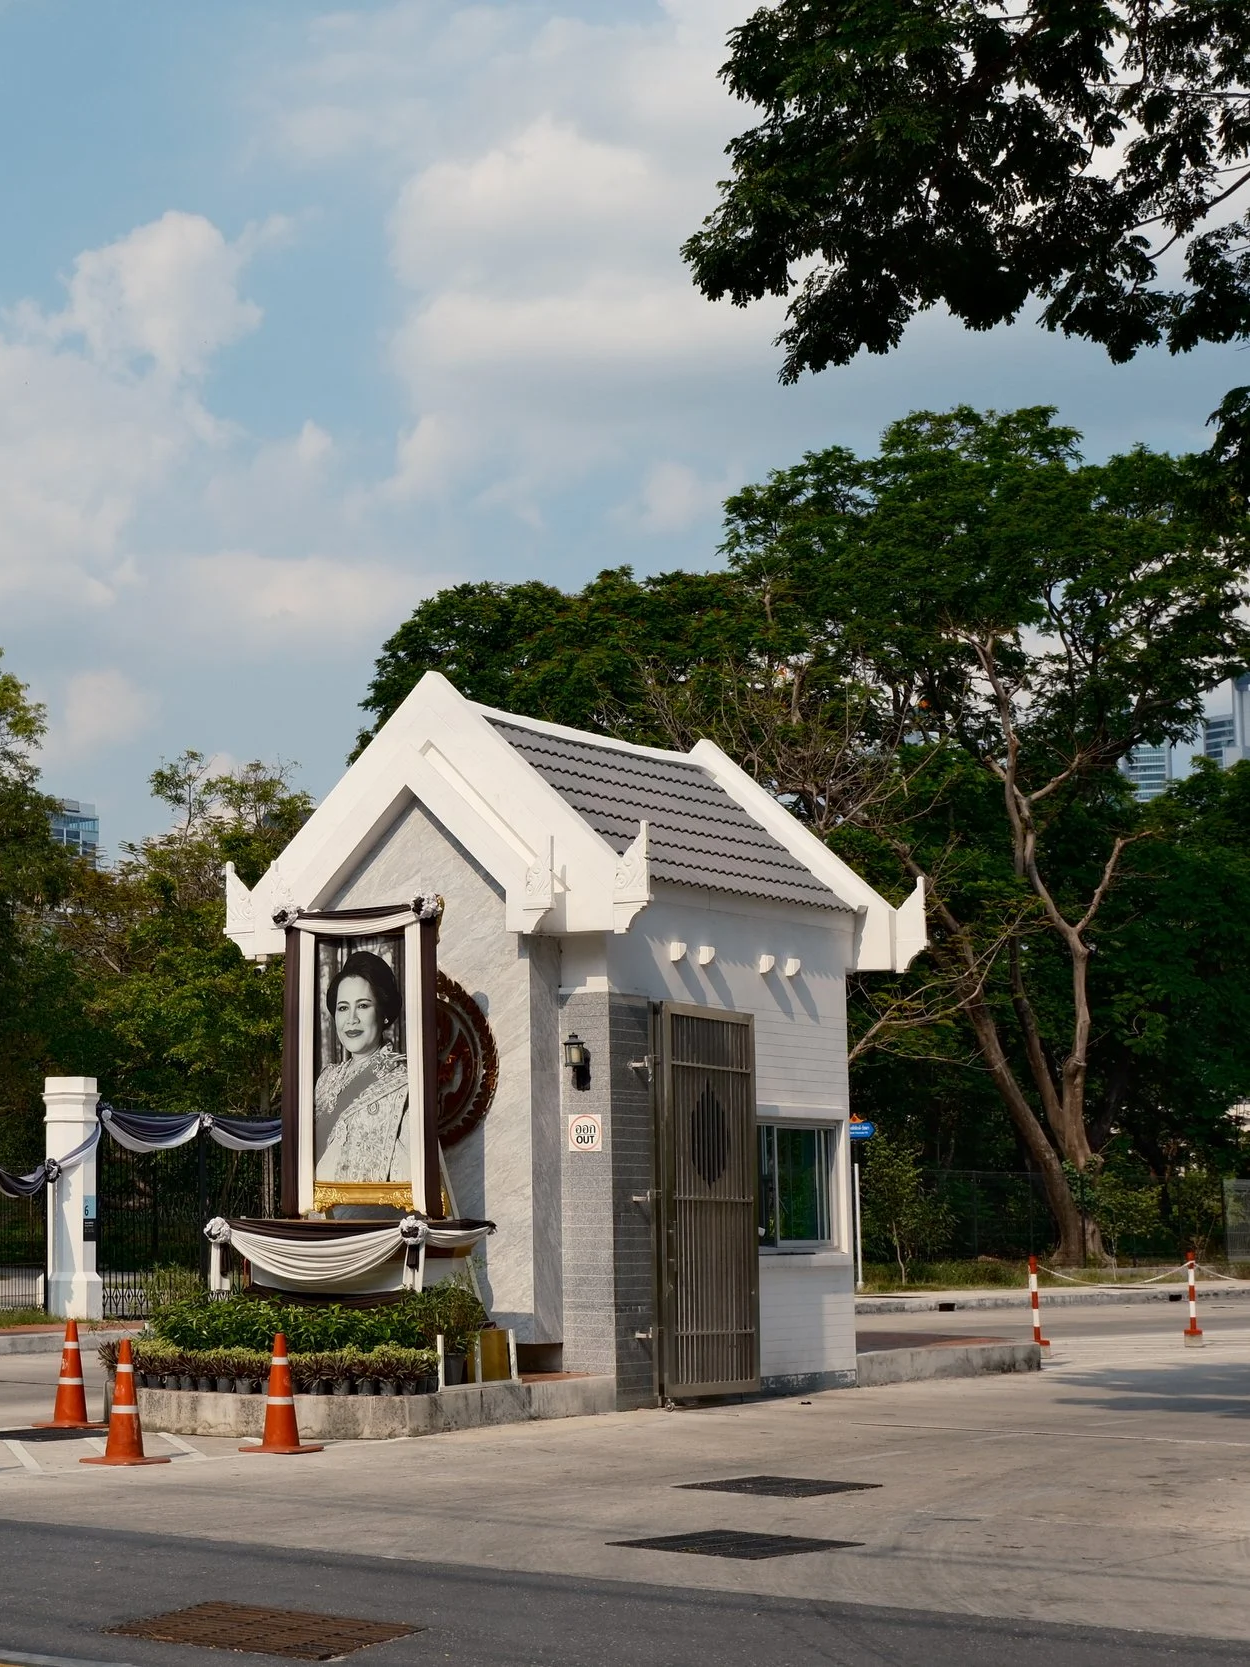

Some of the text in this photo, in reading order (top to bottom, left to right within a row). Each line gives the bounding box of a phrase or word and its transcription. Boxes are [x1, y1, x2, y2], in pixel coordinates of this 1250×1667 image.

[575, 1124, 596, 1134] ออก
[576, 1135, 595, 1144] OUT
[84, 1205, 89, 1216] 6
